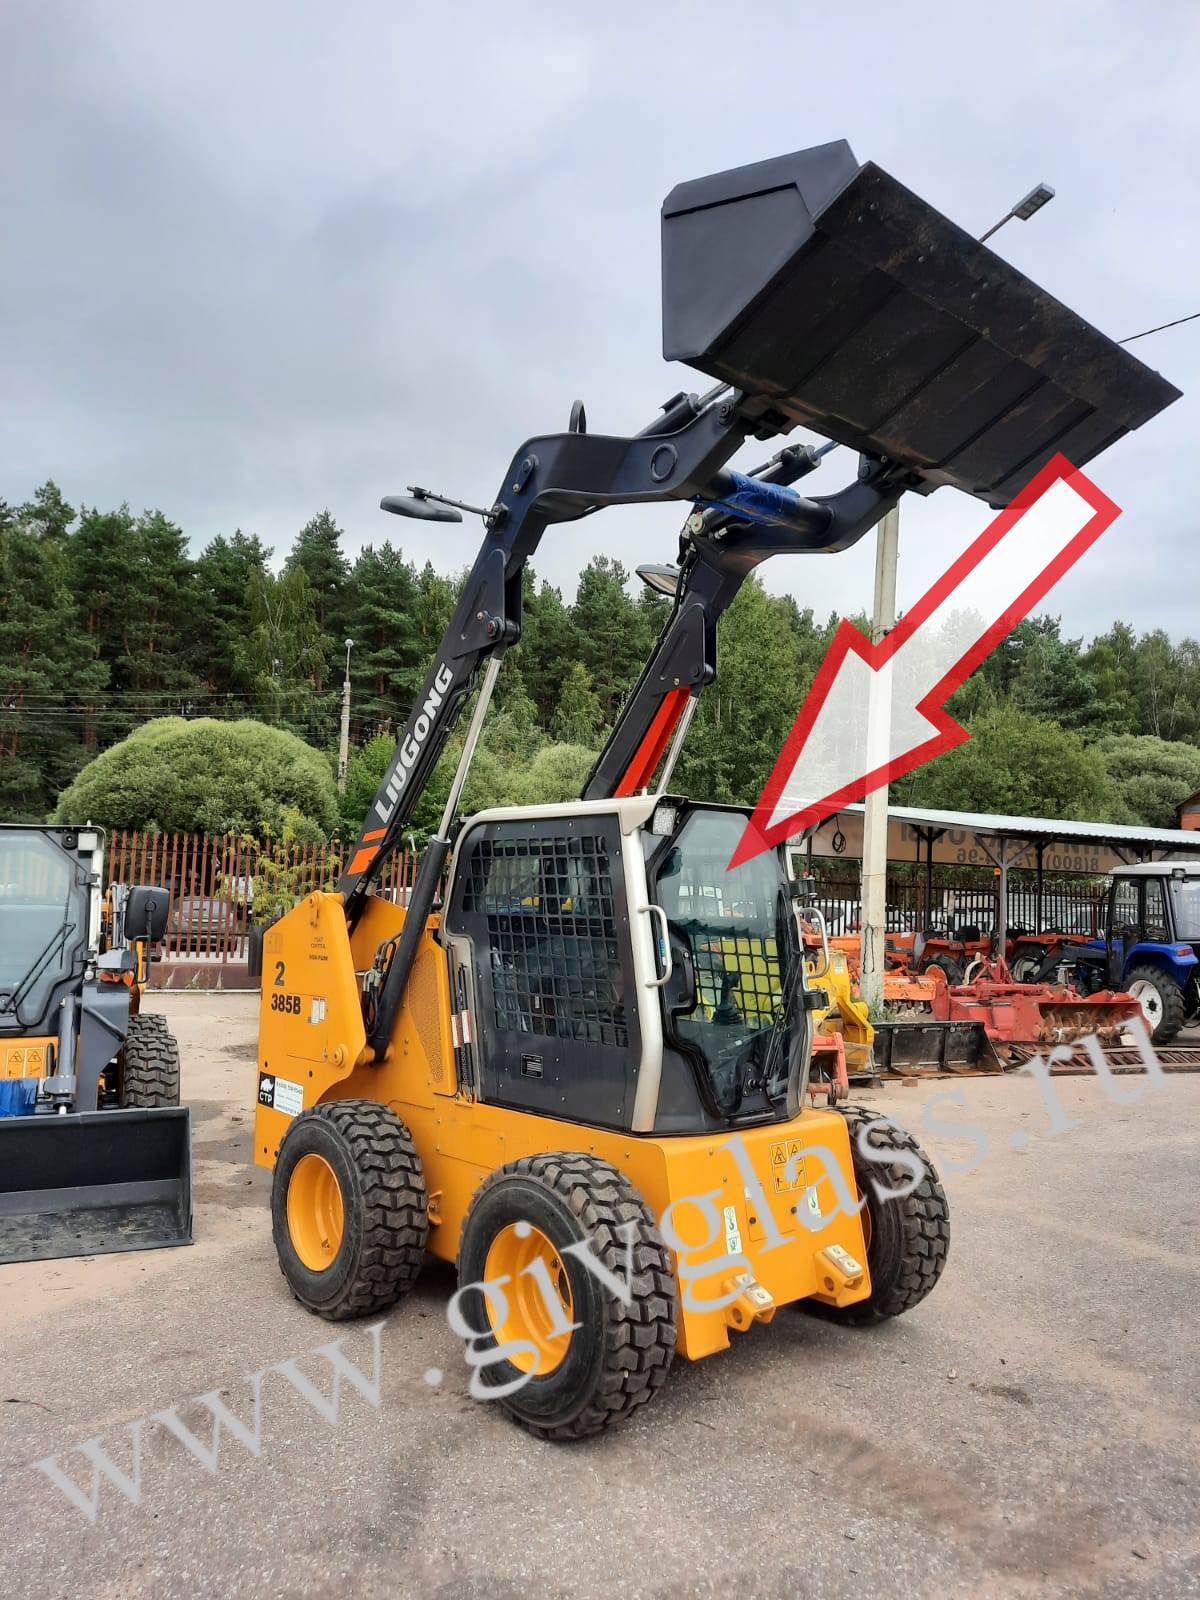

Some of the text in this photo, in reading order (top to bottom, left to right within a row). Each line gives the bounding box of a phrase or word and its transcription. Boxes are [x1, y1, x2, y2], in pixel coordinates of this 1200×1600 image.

[374, 662, 453, 823] LIUGONG
[274, 961, 285, 987] 2
[271, 993, 301, 1015] 385B
